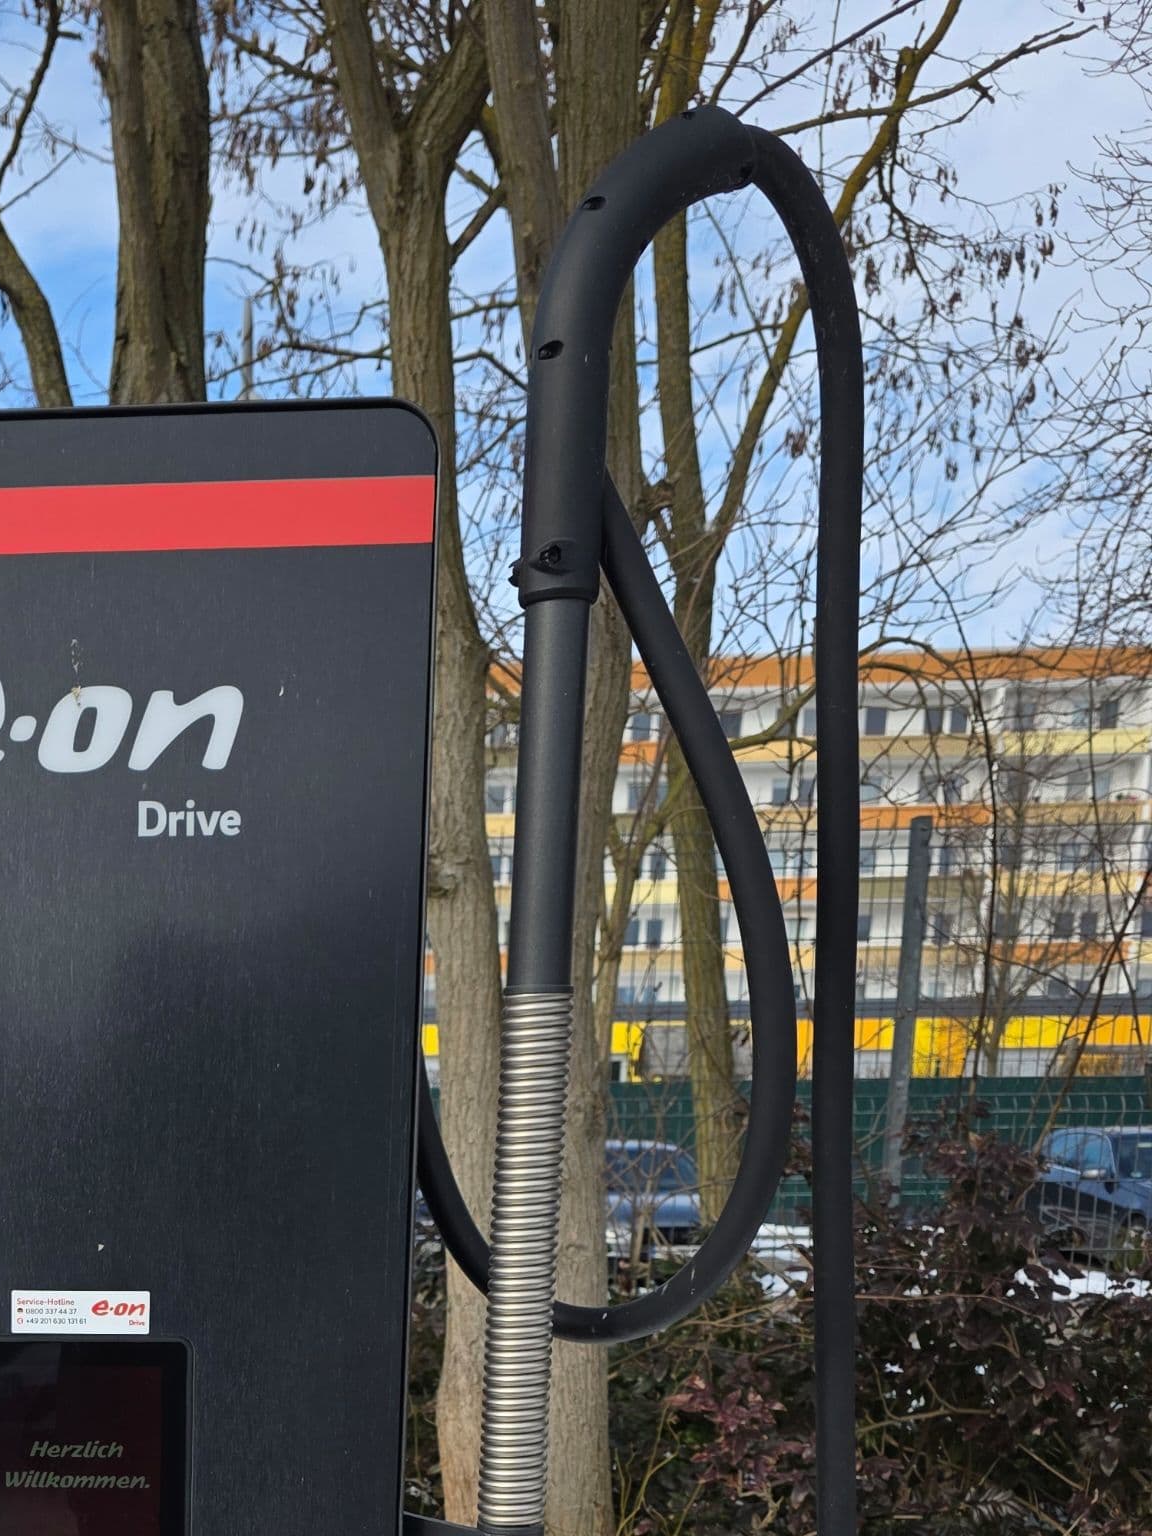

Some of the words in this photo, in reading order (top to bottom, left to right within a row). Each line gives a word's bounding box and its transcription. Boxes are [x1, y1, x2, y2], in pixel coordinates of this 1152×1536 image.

[137, 800, 242, 837] Drive
[16, 1297, 75, 1306] Service-Hotline
[26, 1317, 39, 1325] +49
[30, 1440, 123, 1459] Herzlich
[5, 1470, 150, 1489] Willkommen.
